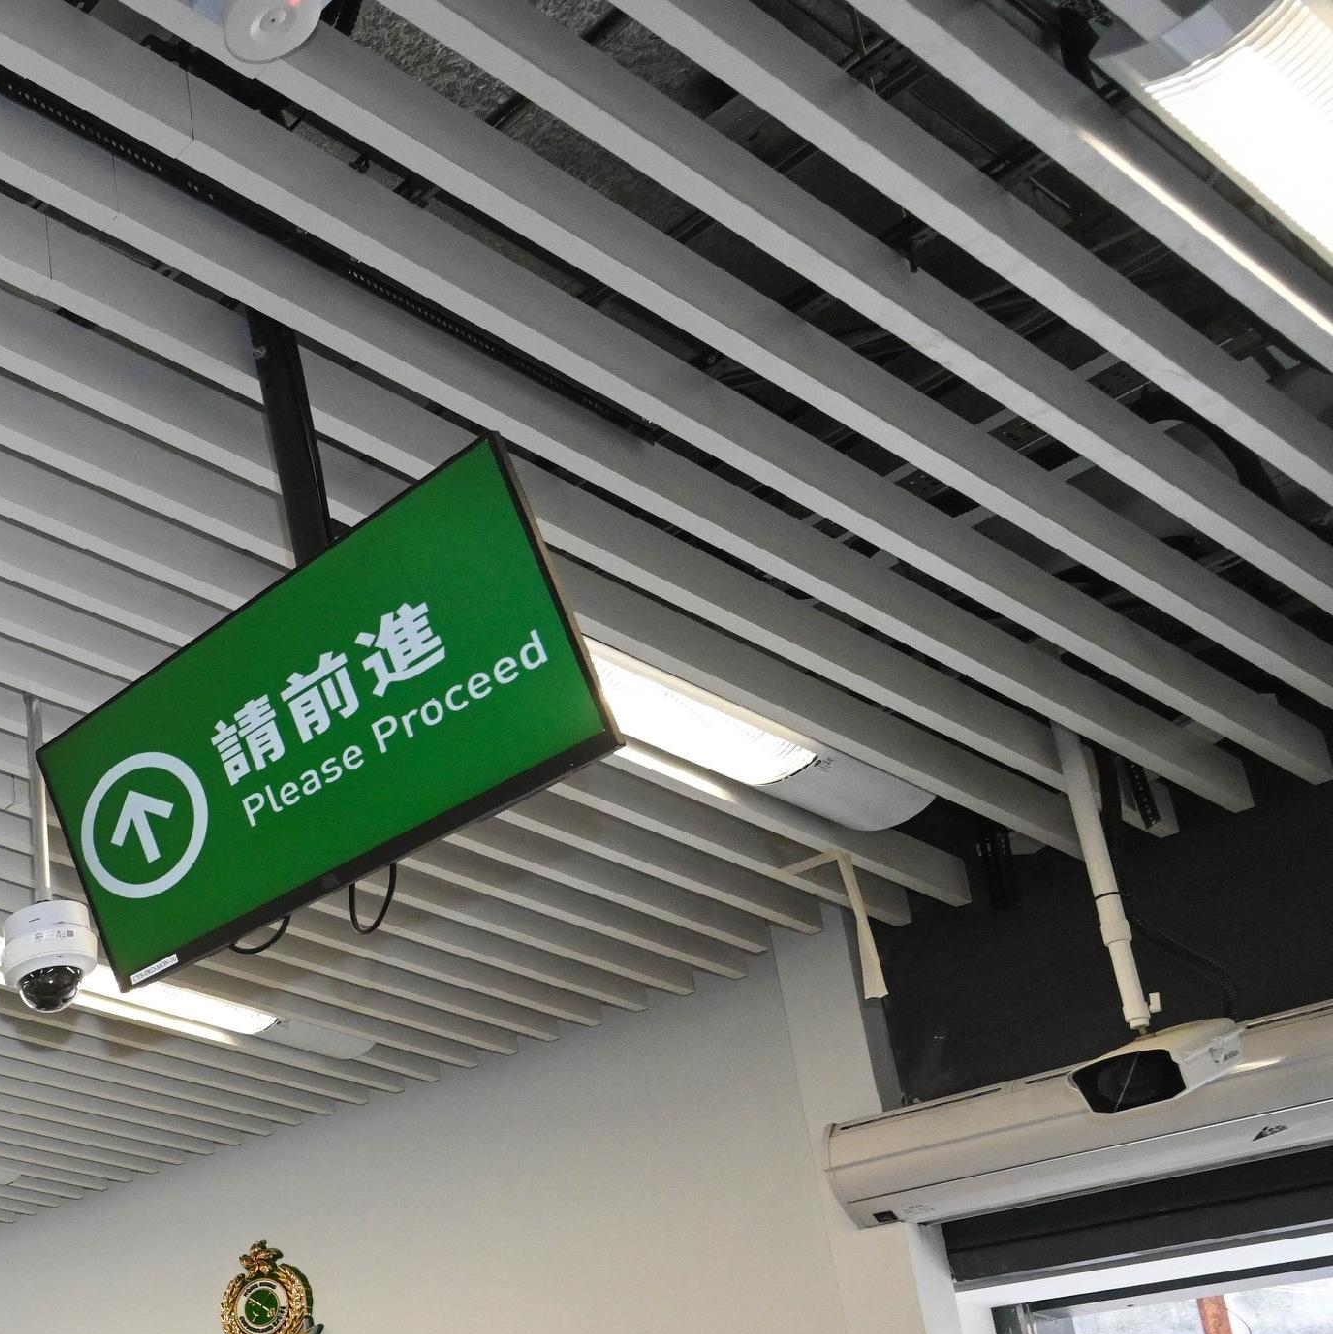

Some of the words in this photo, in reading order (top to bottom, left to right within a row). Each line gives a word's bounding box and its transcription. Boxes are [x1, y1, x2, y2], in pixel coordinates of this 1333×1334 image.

[210, 601, 446, 787] 請前進
[241, 744, 365, 828] Please
[370, 629, 550, 754] Proceed
